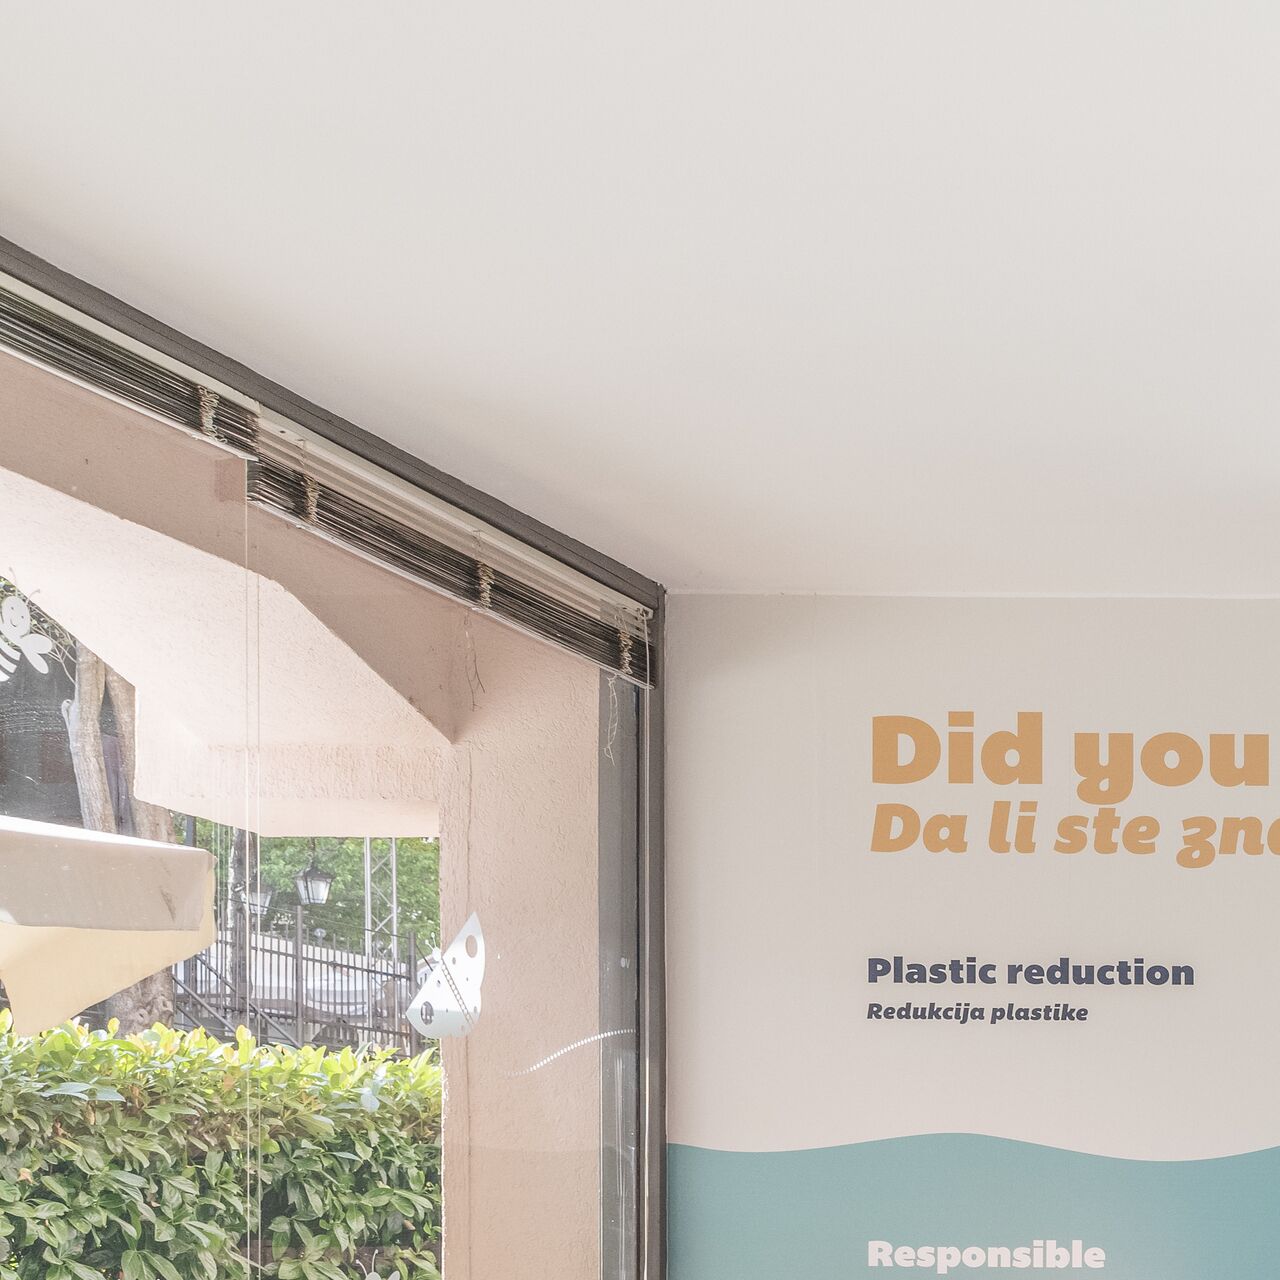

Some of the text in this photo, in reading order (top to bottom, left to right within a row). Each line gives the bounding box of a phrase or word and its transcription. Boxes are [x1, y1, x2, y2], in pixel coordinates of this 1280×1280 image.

[870, 709, 1045, 786] Did
[1073, 731, 1271, 805] you
[869, 802, 969, 855] Da
[987, 799, 1038, 855] li
[1053, 807, 1161, 857] ste
[867, 955, 1195, 986] Plastic reduction
[866, 1001, 1089, 1025] Redukcija plastike
[867, 1239, 1107, 1275] Responsible
